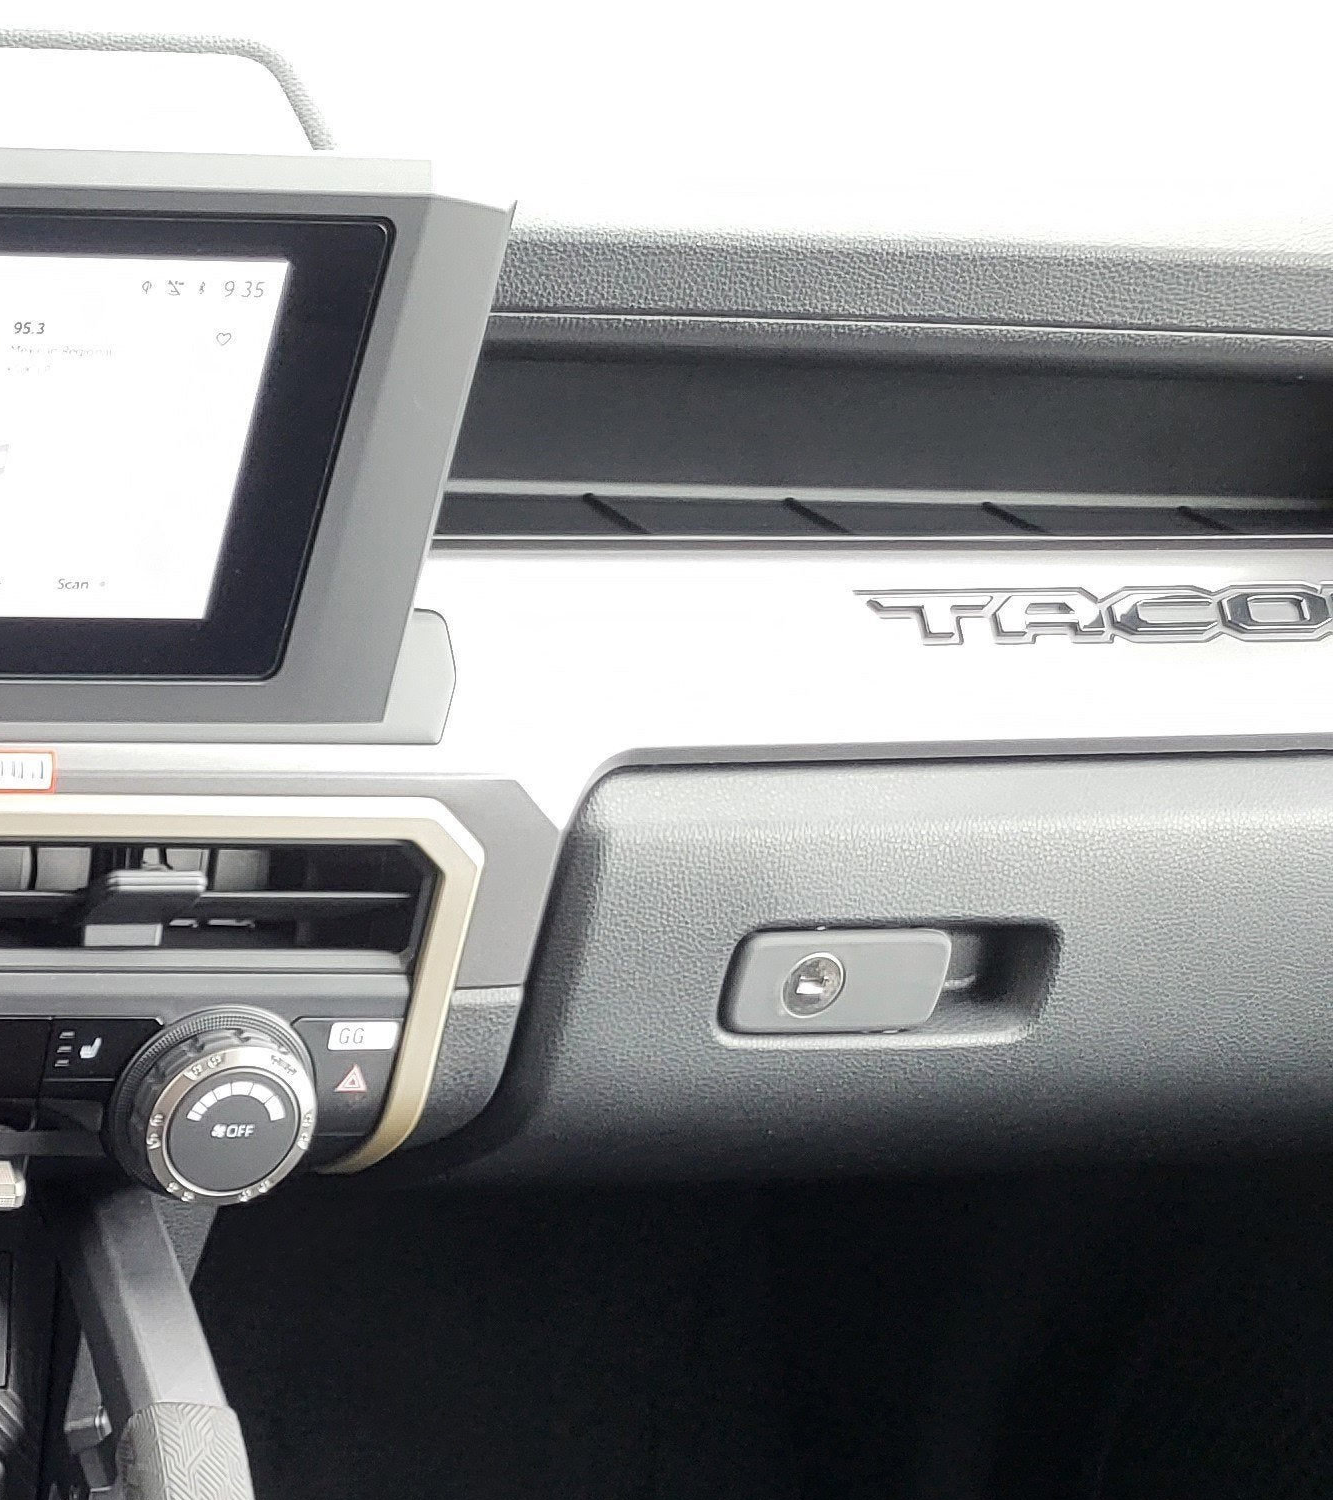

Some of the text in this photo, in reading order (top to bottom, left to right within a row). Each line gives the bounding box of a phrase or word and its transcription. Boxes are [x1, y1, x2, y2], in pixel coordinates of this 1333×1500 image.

[223, 279, 267, 299] 935
[13, 321, 46, 335] 95.3
[56, 577, 90, 590] Scan
[853, 581, 1333, 646] TACO
[225, 1124, 256, 1139] OFF
